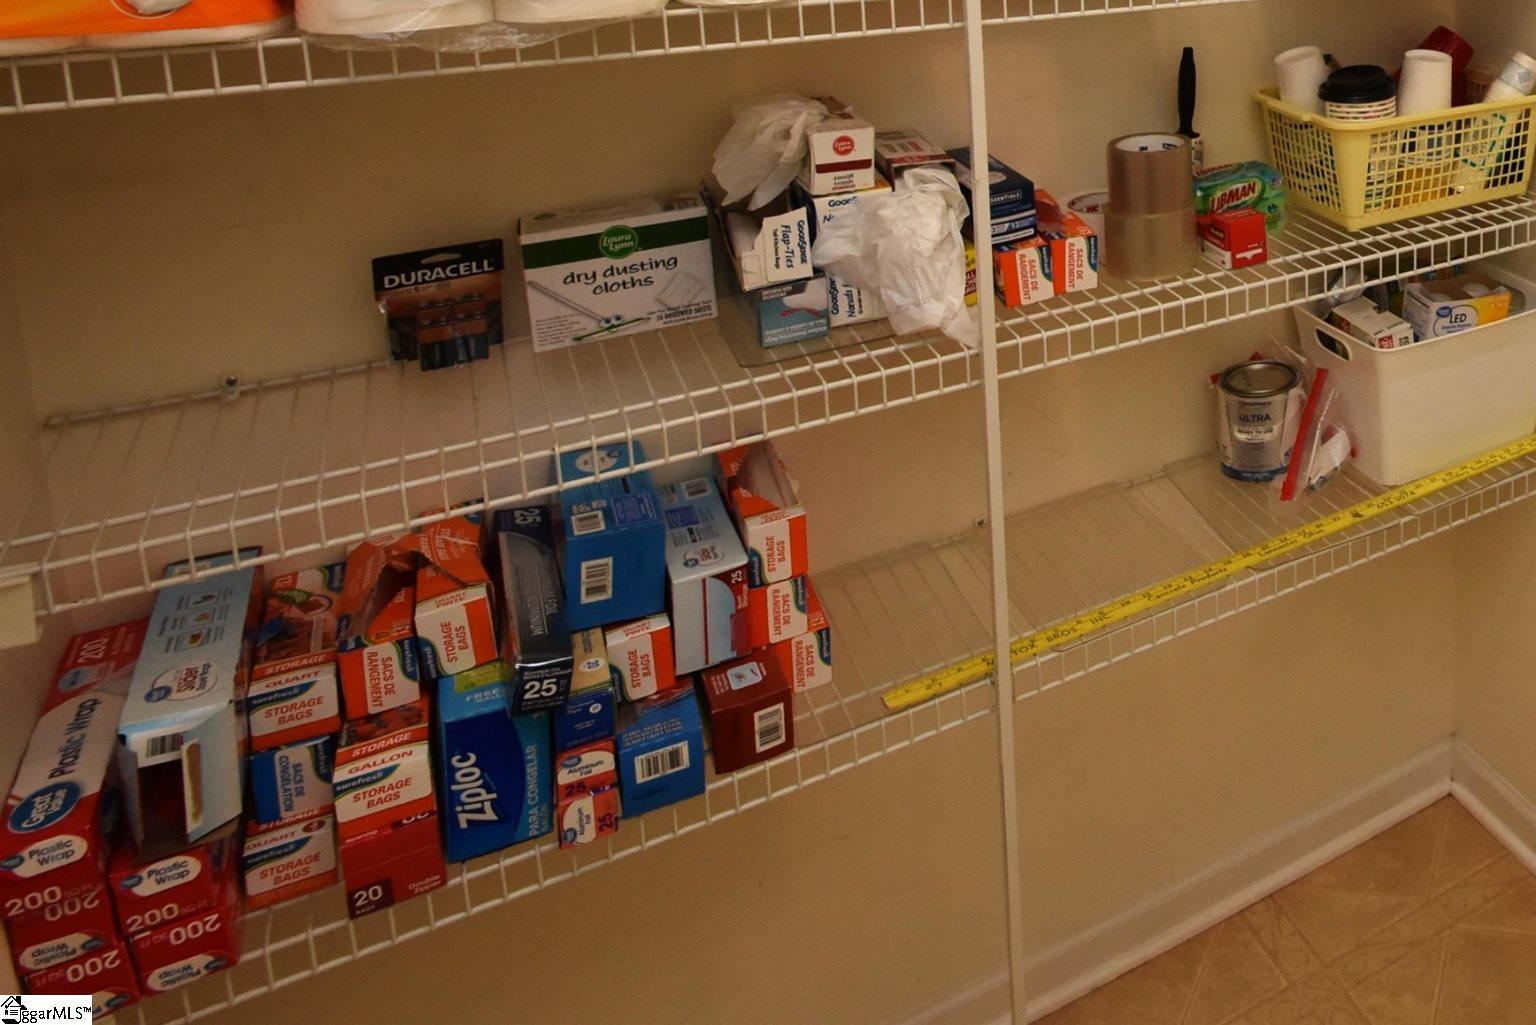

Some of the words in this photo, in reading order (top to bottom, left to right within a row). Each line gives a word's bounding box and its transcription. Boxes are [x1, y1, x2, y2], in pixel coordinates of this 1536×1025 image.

[990, 192, 1021, 203] SSENTIALS
[1210, 181, 1257, 214] LIBMAN
[603, 233, 633, 247] Laura
[609, 241, 634, 253] Lynn
[781, 224, 794, 269] Flap-Ties
[1028, 259, 1037, 279] SACS
[1068, 242, 1076, 288] RANGEMENT
[1076, 249, 1084, 270] SACS
[384, 259, 495, 289] DURACELL
[563, 270, 597, 286] dry
[603, 256, 679, 277] dusting
[1018, 254, 1031, 300] RANGEMENT
[1076, 271, 1084, 281] DE
[592, 276, 655, 296] cloths
[1031, 280, 1039, 291] DE
[1450, 312, 1467, 324] LED
[1239, 414, 1272, 423] ULTRA
[766, 536, 776, 572] STORAGE
[776, 540, 786, 563] BAGS
[730, 570, 743, 584] 25
[773, 589, 782, 636] RANGEMENT
[781, 593, 790, 613] SACS
[782, 614, 791, 626] DE
[441, 622, 457, 663] STORAGE
[455, 626, 469, 651] BAGS
[265, 655, 327, 675] STORAGE
[642, 653, 651, 678] BAGS
[795, 640, 806, 688] RANGEMENT
[805, 644, 814, 665] SACS
[265, 670, 320, 689] QUART
[367, 651, 383, 708] RANGEMENT
[381, 657, 394, 683] SACS
[628, 649, 641, 689] STORAGE
[805, 666, 815, 678] DE
[252, 689, 299, 705] surefresh
[384, 684, 395, 696] DE
[523, 678, 558, 700] 25
[64, 698, 102, 736] Wrap
[265, 695, 324, 718] STORAGE
[278, 709, 313, 726] BAGS
[352, 732, 412, 757] STORAGE
[48, 735, 85, 780] Plastic
[347, 750, 413, 774] GALLON
[567, 760, 605, 776] Aluminum
[335, 771, 384, 792] surefresh
[526, 744, 539, 805] CONGELAR
[352, 777, 413, 803] STORAGE
[450, 751, 499, 830] Ziploc
[565, 782, 587, 795] 25
[366, 792, 401, 809] BAGS
[529, 805, 539, 837] PARA
[598, 813, 613, 832] 25
[29, 839, 73, 858] Plastic
[246, 830, 298, 851] QUART
[37, 849, 75, 866] Wrap
[147, 860, 189, 876] Plastic
[259, 852, 322, 879] STORAGE
[155, 869, 190, 886] Wrap
[274, 866, 310, 885] BAGS
[4, 886, 62, 917] 200
[44, 890, 100, 922] 200
[353, 885, 383, 907] 20
[126, 903, 180, 932] 200
[169, 913, 221, 946] 200
[66, 949, 122, 983] 200
